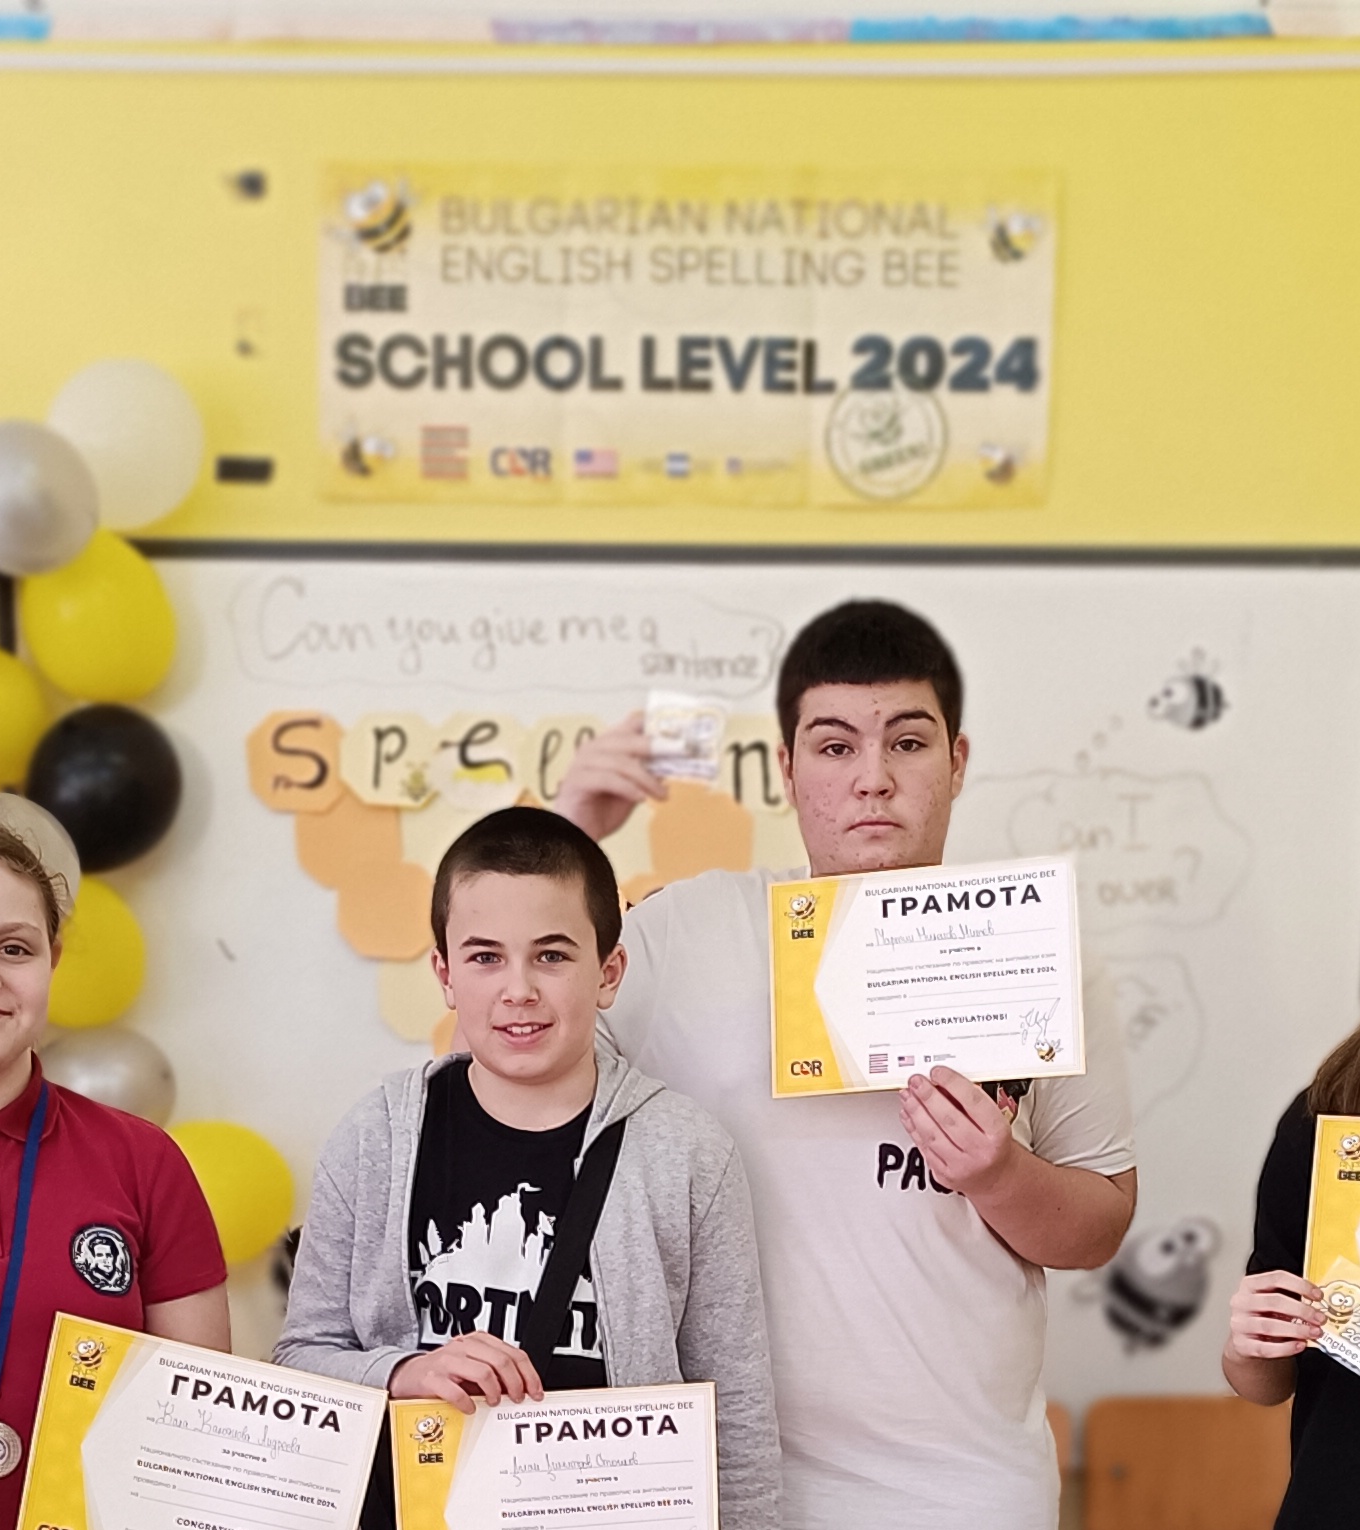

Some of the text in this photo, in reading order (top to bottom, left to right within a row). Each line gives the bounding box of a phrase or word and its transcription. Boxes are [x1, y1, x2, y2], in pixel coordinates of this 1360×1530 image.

[439, 197, 957, 240] BULGARIAN NATIONAL
[440, 243, 632, 286] ENGLISH
[649, 244, 866, 288] SPELLING
[882, 247, 959, 289] BEE
[344, 284, 407, 312] BEE
[335, 332, 1040, 395] SCHOOL LEVEL 2024
[256, 575, 376, 663] Can
[387, 615, 461, 675] you
[469, 606, 546, 673] give
[559, 614, 630, 645] me
[864, 869, 1056, 896] BULGARIAN NATIONAL ENGLISH SPELLING BEE
[881, 884, 1041, 918] ГРАМОТА
[914, 1013, 1007, 1027] CONGRATULATIONS!
[877, 1143, 966, 1197] PA
[69, 1375, 97, 1391] BEE
[158, 1357, 362, 1411] BULGARIAN NATIONAL ENGLISH SPELLING BEE
[170, 1374, 340, 1432] ГРАМОТА
[496, 1401, 693, 1420] BULGARIAN NATIONAL ENGLISH SPELLING BEE
[515, 1414, 678, 1444] ГРАМОТА
[418, 1453, 444, 1464] BEE
